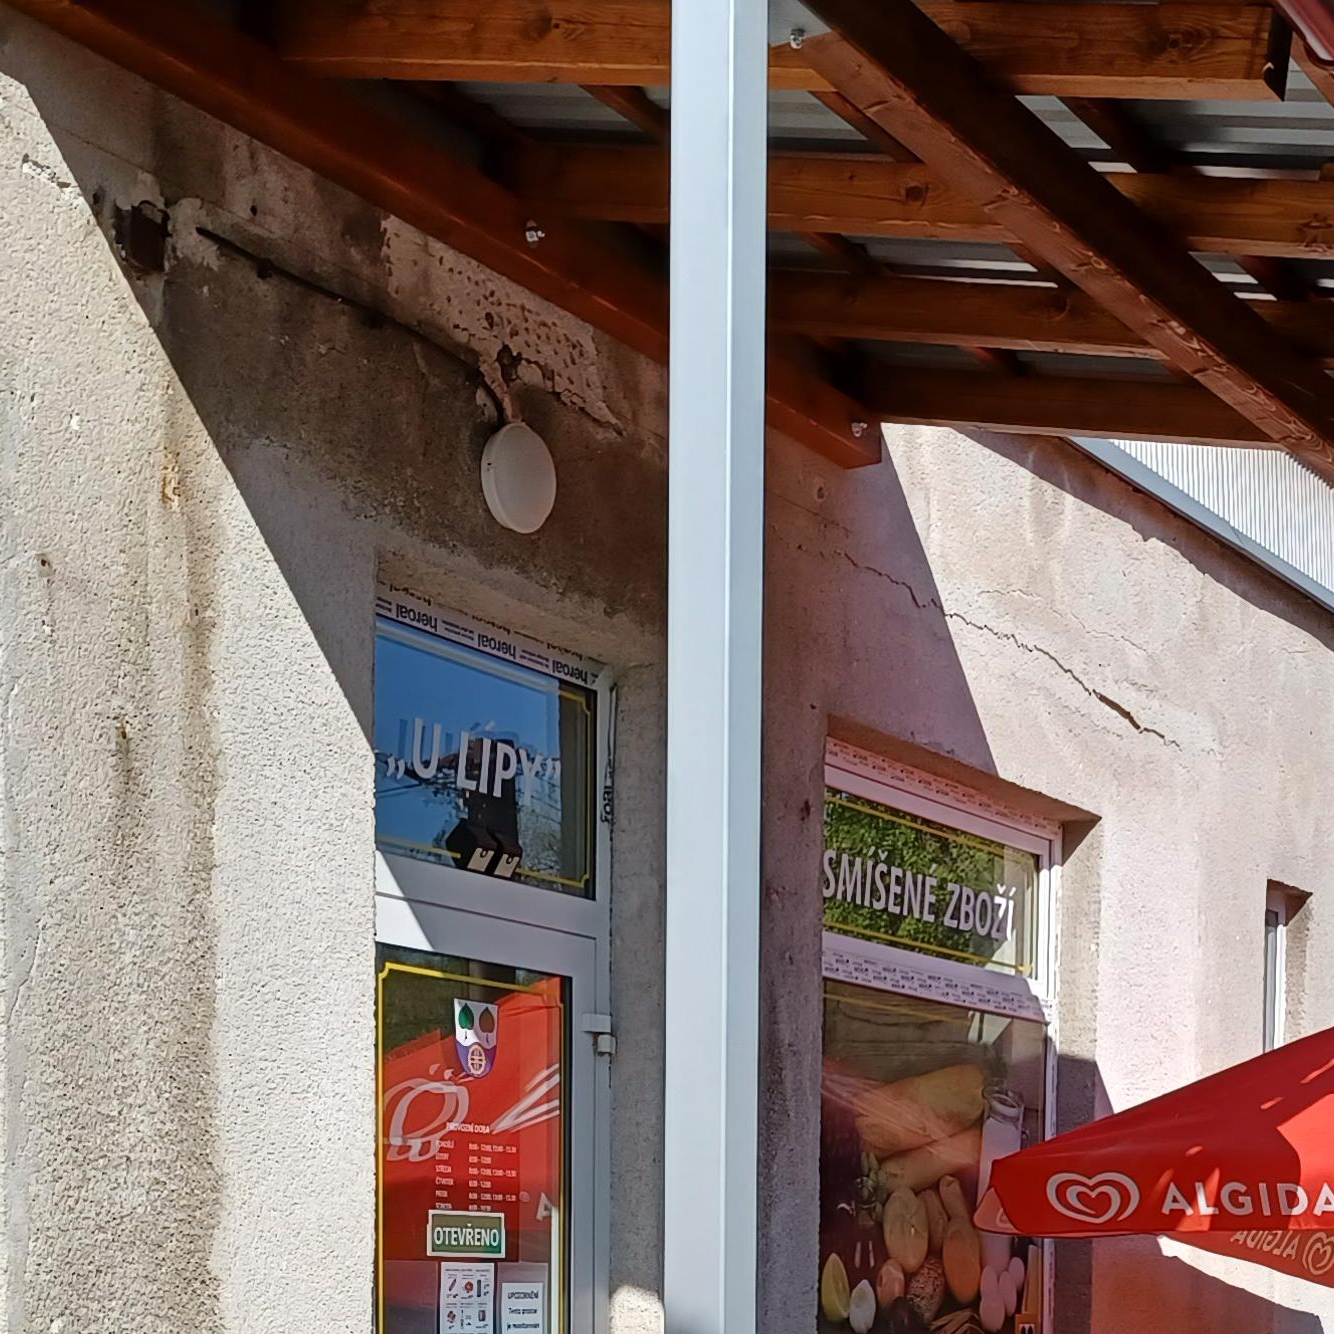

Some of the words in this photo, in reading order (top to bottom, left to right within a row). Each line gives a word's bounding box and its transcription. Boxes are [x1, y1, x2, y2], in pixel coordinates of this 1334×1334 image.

[396, 603, 438, 632] heroal
[478, 633, 516, 659] heroal
[552, 659, 588, 685] heroal
[822, 846, 938, 923] SMÍŠENÉ
[943, 882, 1016, 943] ZBOŽÍ
[434, 1223, 500, 1247] OTEVŘENO
